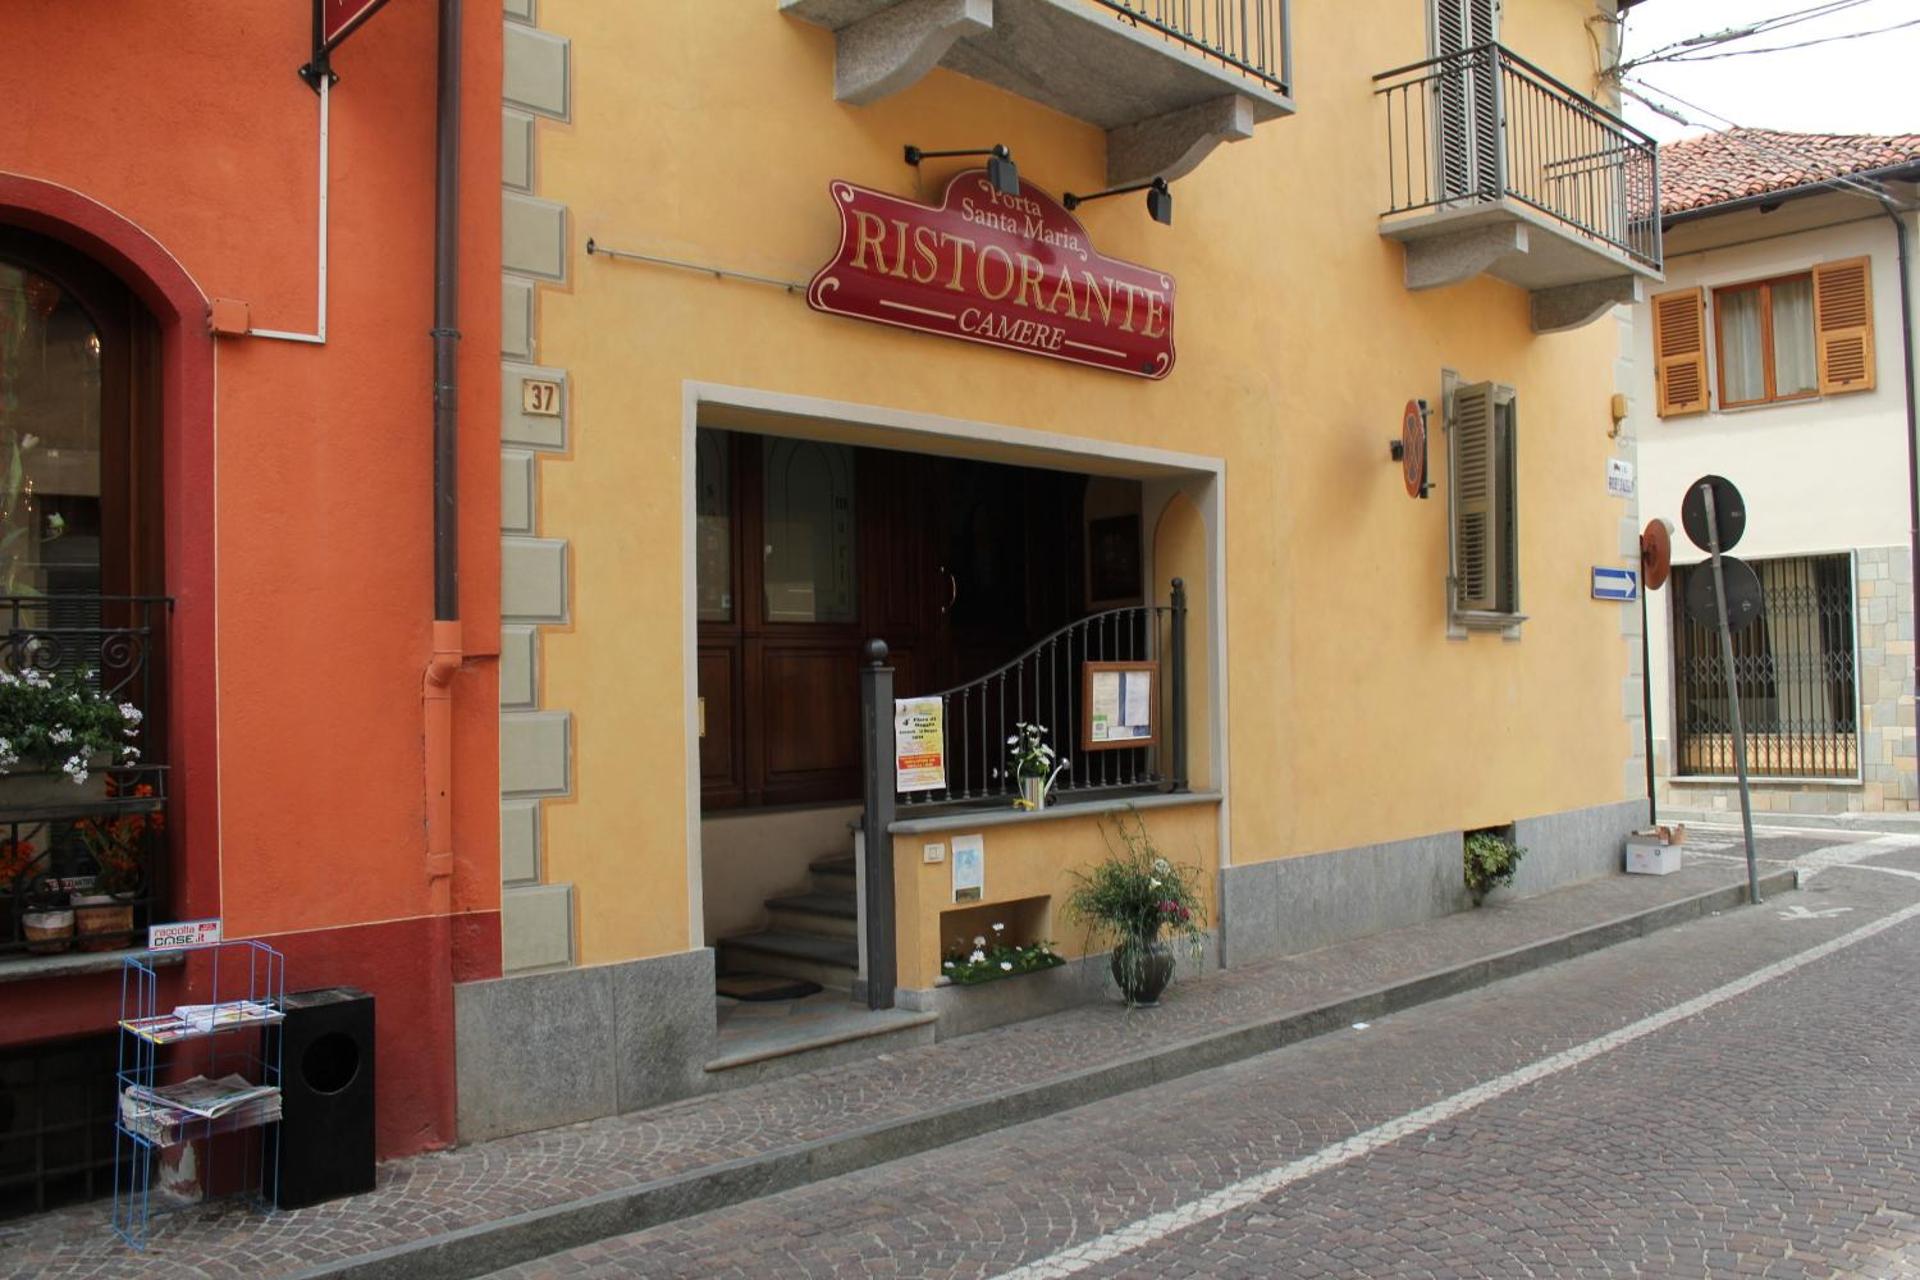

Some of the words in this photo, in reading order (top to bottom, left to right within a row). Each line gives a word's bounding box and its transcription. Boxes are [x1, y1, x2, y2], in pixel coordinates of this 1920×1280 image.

[961, 197, 1017, 234] Santa
[1024, 214, 1087, 261] Maria
[850, 209, 1166, 338] RISTORANTE
[958, 307, 1067, 351] CAMERE
[532, 384, 554, 411] 37
[155, 924, 195, 937] raccolta
